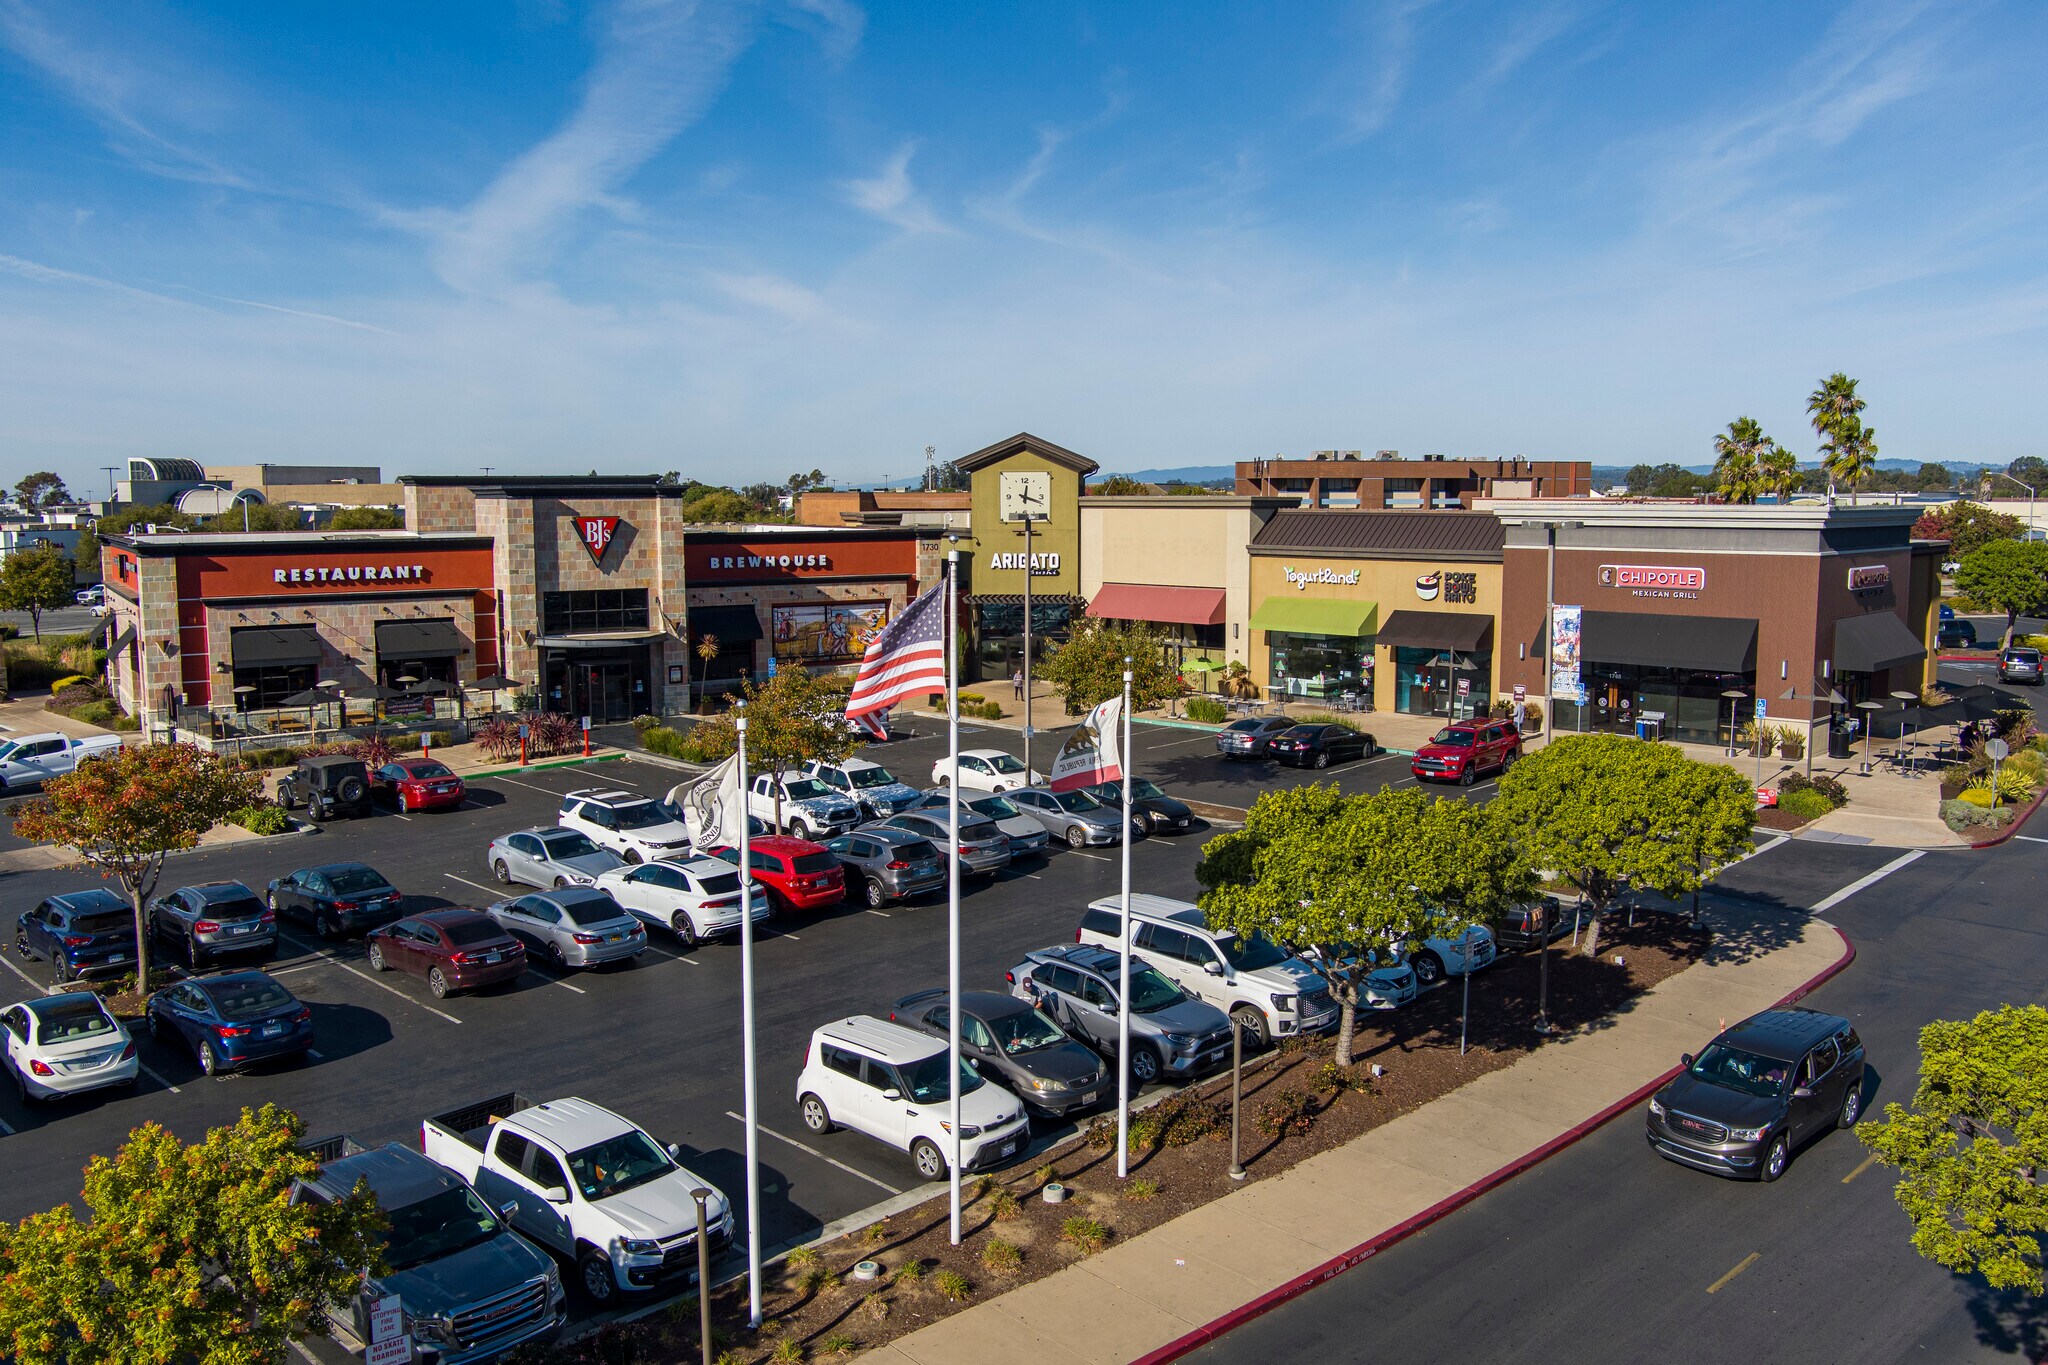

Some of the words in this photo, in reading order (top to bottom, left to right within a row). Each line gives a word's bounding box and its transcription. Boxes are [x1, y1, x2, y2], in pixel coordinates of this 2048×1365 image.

[586, 519, 611, 550] BJ's
[922, 543, 939, 551] 1730
[710, 554, 827, 569] BREWHOUSE
[274, 565, 423, 583] RESTAURANT
[1283, 566, 1357, 591] Yogurtland
[1444, 572, 1477, 583] POKE
[1620, 571, 1697, 586] CHIPOTLE
[1444, 582, 1477, 593] BOWL
[1632, 590, 1670, 598] MEXICAN
[1673, 591, 1698, 599] GRILL
[698, 825, 720, 845] ORNIA
[1682, 1119, 1706, 1131] GMC
[371, 1301, 380, 1311] NO
[372, 1306, 401, 1321] STOPPING
[381, 1317, 394, 1325] FIRE
[381, 1324, 395, 1333] LANE
[373, 1341, 383, 1353] NO
[384, 1338, 404, 1349] SKATE
[371, 1347, 406, 1362] BOARDING
